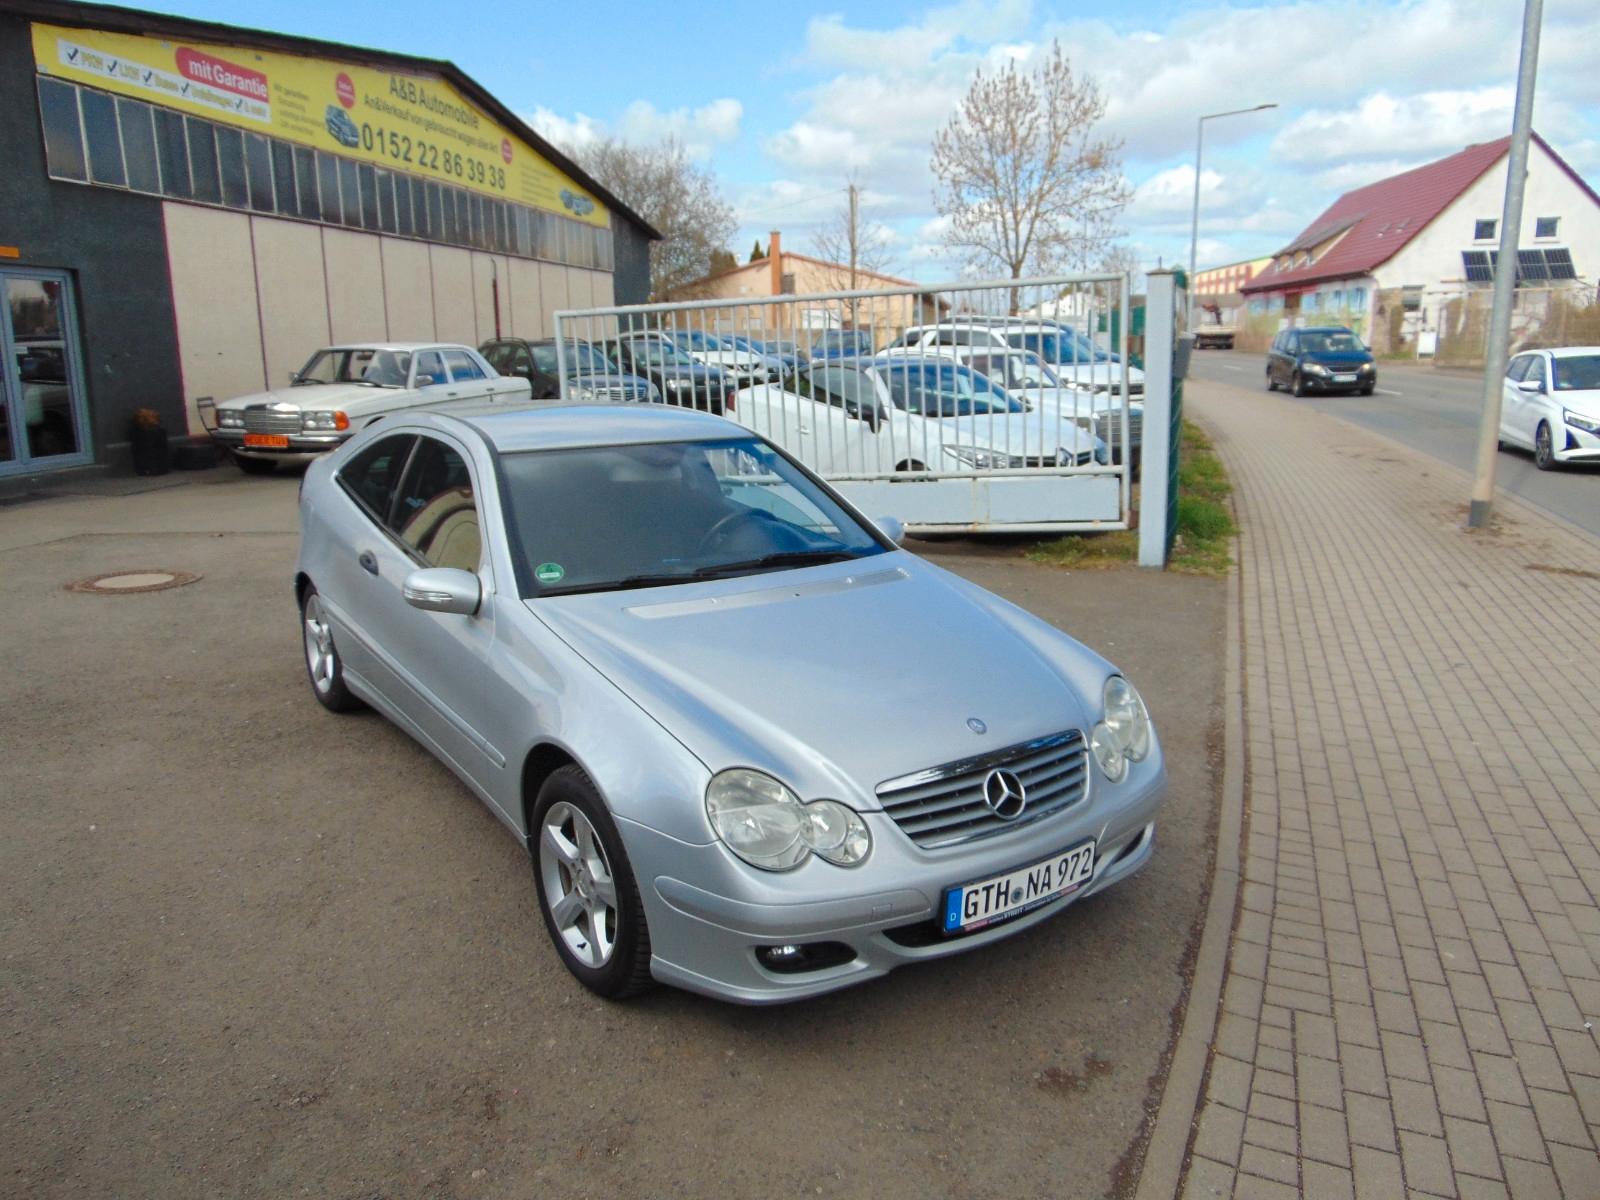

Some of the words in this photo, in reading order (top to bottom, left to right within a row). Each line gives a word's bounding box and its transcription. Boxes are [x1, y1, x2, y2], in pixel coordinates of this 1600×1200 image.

[188, 60, 212, 81] mit
[213, 64, 267, 97] Garantie
[390, 76, 417, 104] A&B
[419, 88, 479, 129] Automobile
[362, 122, 412, 162] 0152
[417, 140, 438, 170] 22
[443, 149, 462, 177] 86
[467, 158, 485, 183] 39
[489, 165, 505, 190] 38
[964, 879, 1011, 919] GTH
[1026, 865, 1051, 899] NA
[1058, 848, 1092, 887] 972
[950, 912, 956, 921] D
